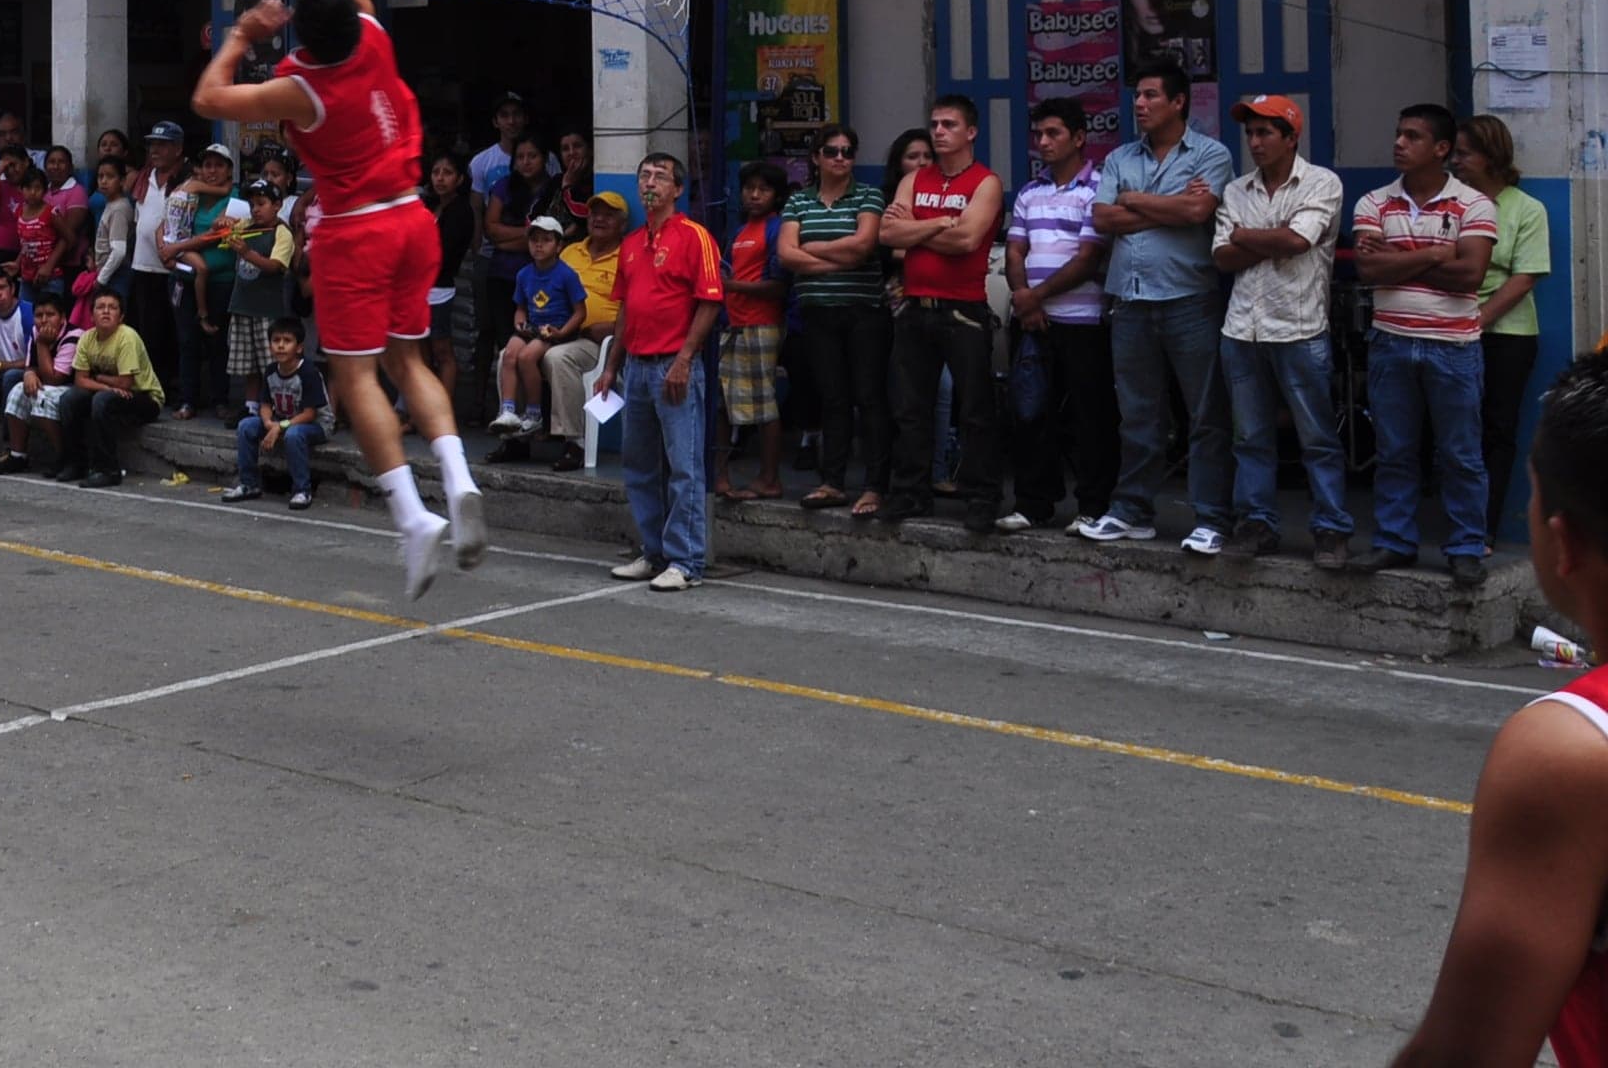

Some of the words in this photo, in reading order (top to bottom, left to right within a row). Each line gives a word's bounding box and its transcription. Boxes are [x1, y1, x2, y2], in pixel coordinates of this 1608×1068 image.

[748, 11, 830, 36] HUGGIES
[1029, 11, 1118, 37] Babysec
[1030, 61, 1118, 85] Babysec
